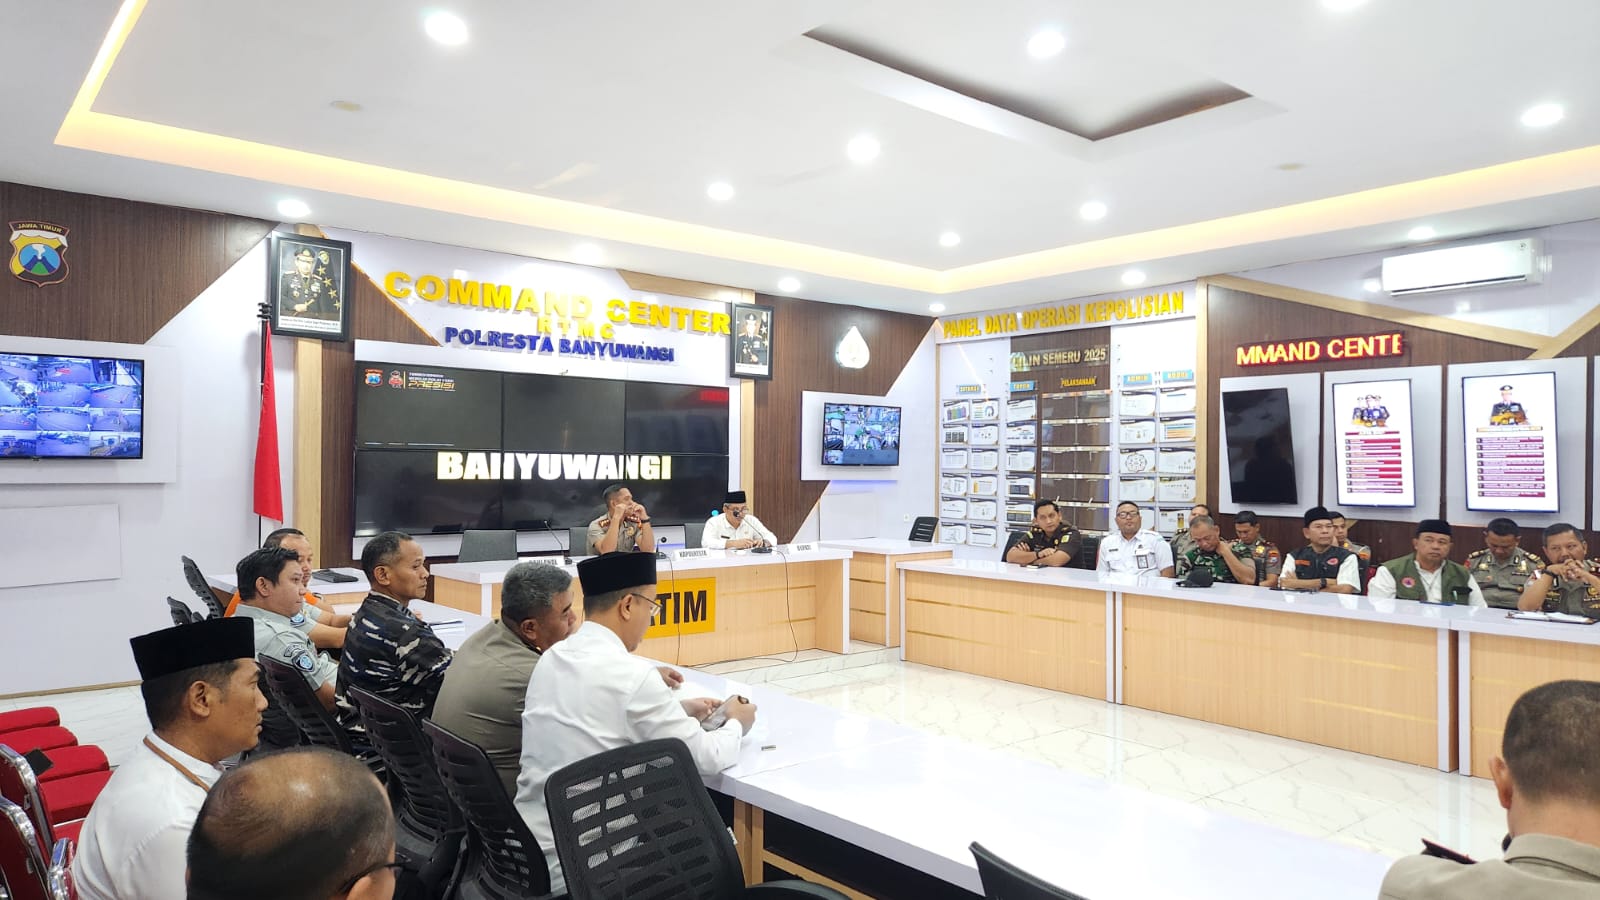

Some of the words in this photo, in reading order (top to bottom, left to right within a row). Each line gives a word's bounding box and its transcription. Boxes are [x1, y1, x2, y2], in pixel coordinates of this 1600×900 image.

[40, 224, 63, 233] TIMUR
[384, 270, 593, 318] COMMAND
[606, 299, 731, 335] CENTER
[943, 316, 982, 339] PANEL
[984, 313, 1018, 335] DATA
[1022, 303, 1081, 330] OPERASI
[1085, 290, 1185, 323] KEPOLISIAN
[445, 326, 555, 353] POLRESTA
[558, 338, 675, 363] BANYUWANGI
[1042, 350, 1081, 365] SEMERU
[1083, 347, 1106, 362] 2025
[1236, 340, 1321, 366] MMAND
[1327, 333, 1403, 359] CENTE
[408, 380, 455, 390] PRESISI
[436, 451, 672, 480] BANYUWANGI
